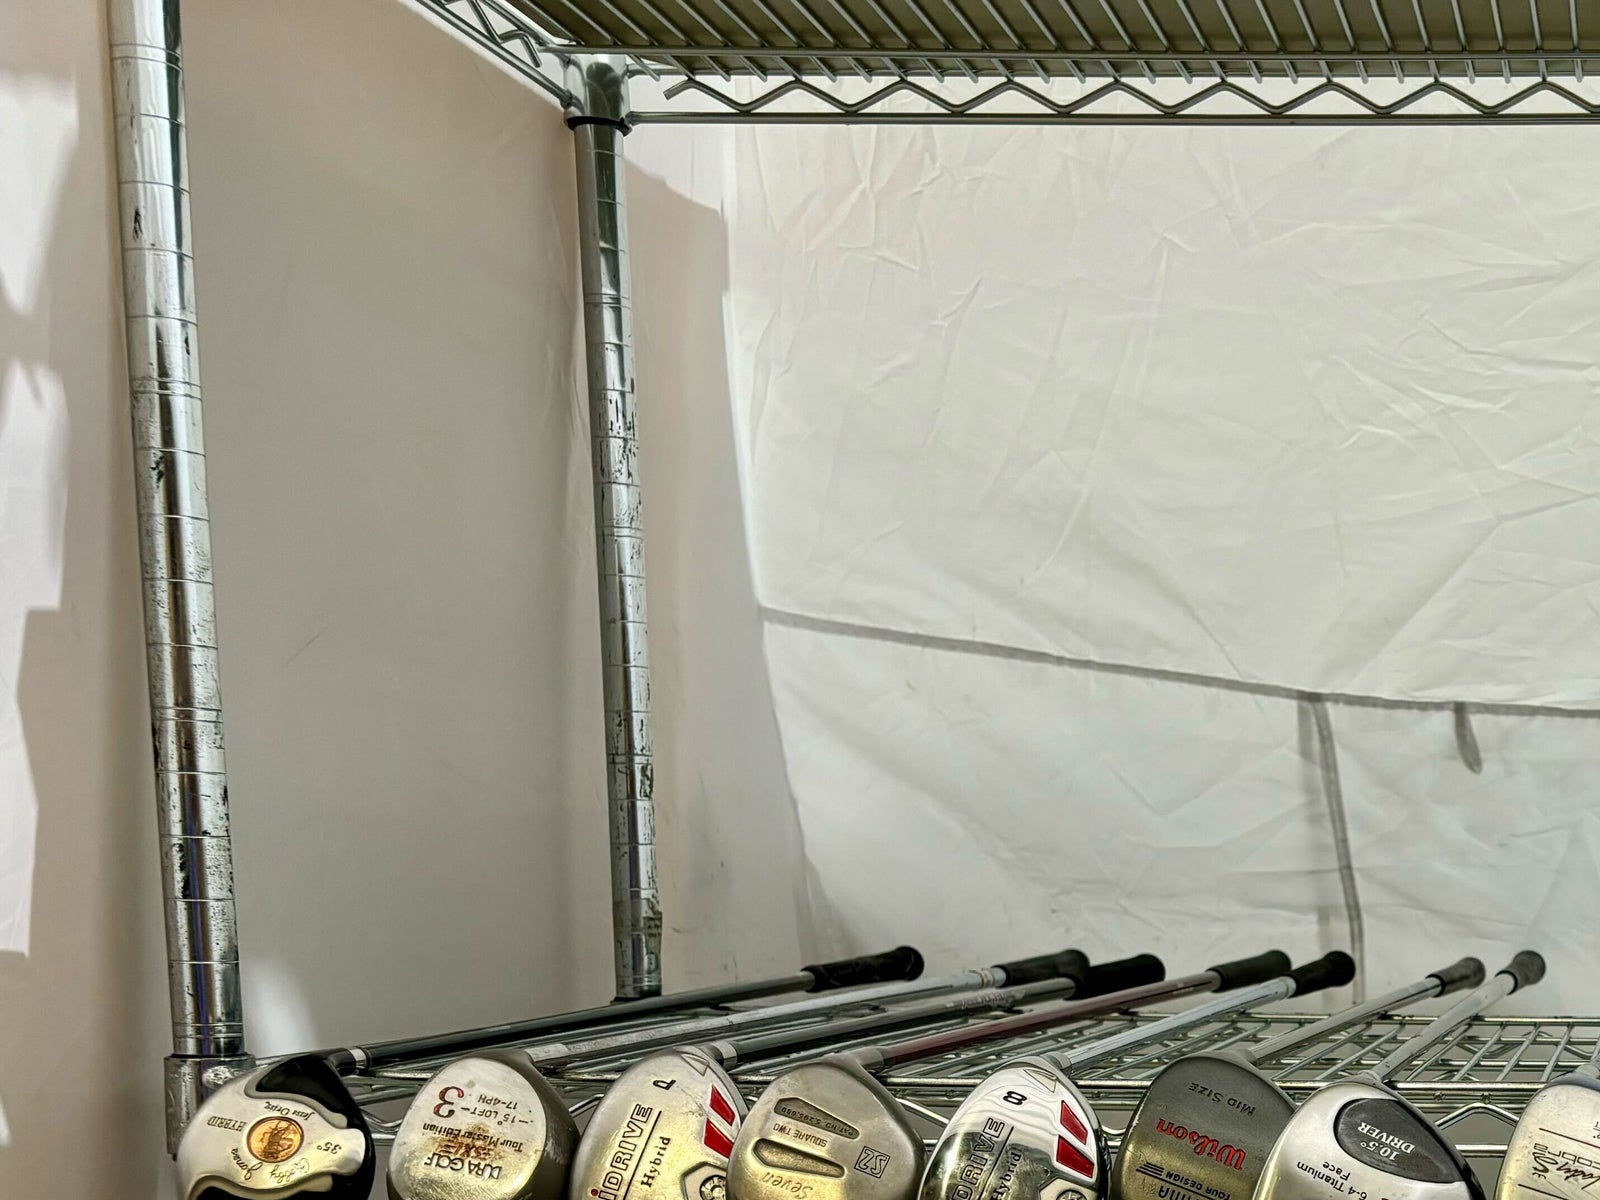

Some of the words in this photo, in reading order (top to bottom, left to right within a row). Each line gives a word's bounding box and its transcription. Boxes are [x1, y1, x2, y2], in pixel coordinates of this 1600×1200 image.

[1003, 1090, 1027, 1105] 8
[1189, 1082, 1223, 1100] SIZE
[434, 1087, 464, 1118] 3
[478, 1094, 518, 1109] 17-4PH
[1228, 1098, 1255, 1115] MID
[208, 1116, 246, 1131] HYBRID
[423, 1123, 461, 1139] Edition
[773, 1123, 791, 1134] TWO
[461, 1131, 496, 1147] Master
[496, 1139, 523, 1152] Tour
[793, 1129, 827, 1147] SQUARE
[1155, 1118, 1246, 1170] Wilson
[1357, 1122, 1415, 1154] DRIVER
[317, 1142, 342, 1154] 35°
[1359, 1139, 1399, 1159] 10.5°
[424, 1154, 464, 1170] GOLF
[640, 1136, 671, 1187] Hybrid
[1322, 1160, 1350, 1180] Face
[468, 1162, 502, 1179] DURA
[1297, 1160, 1349, 1193] Titanium
[762, 1172, 813, 1199] Seven
[1166, 1170, 1204, 1190] DESIGN
[1205, 1184, 1230, 1200] TOUR
[1349, 1185, 1368, 1200] 6-4
